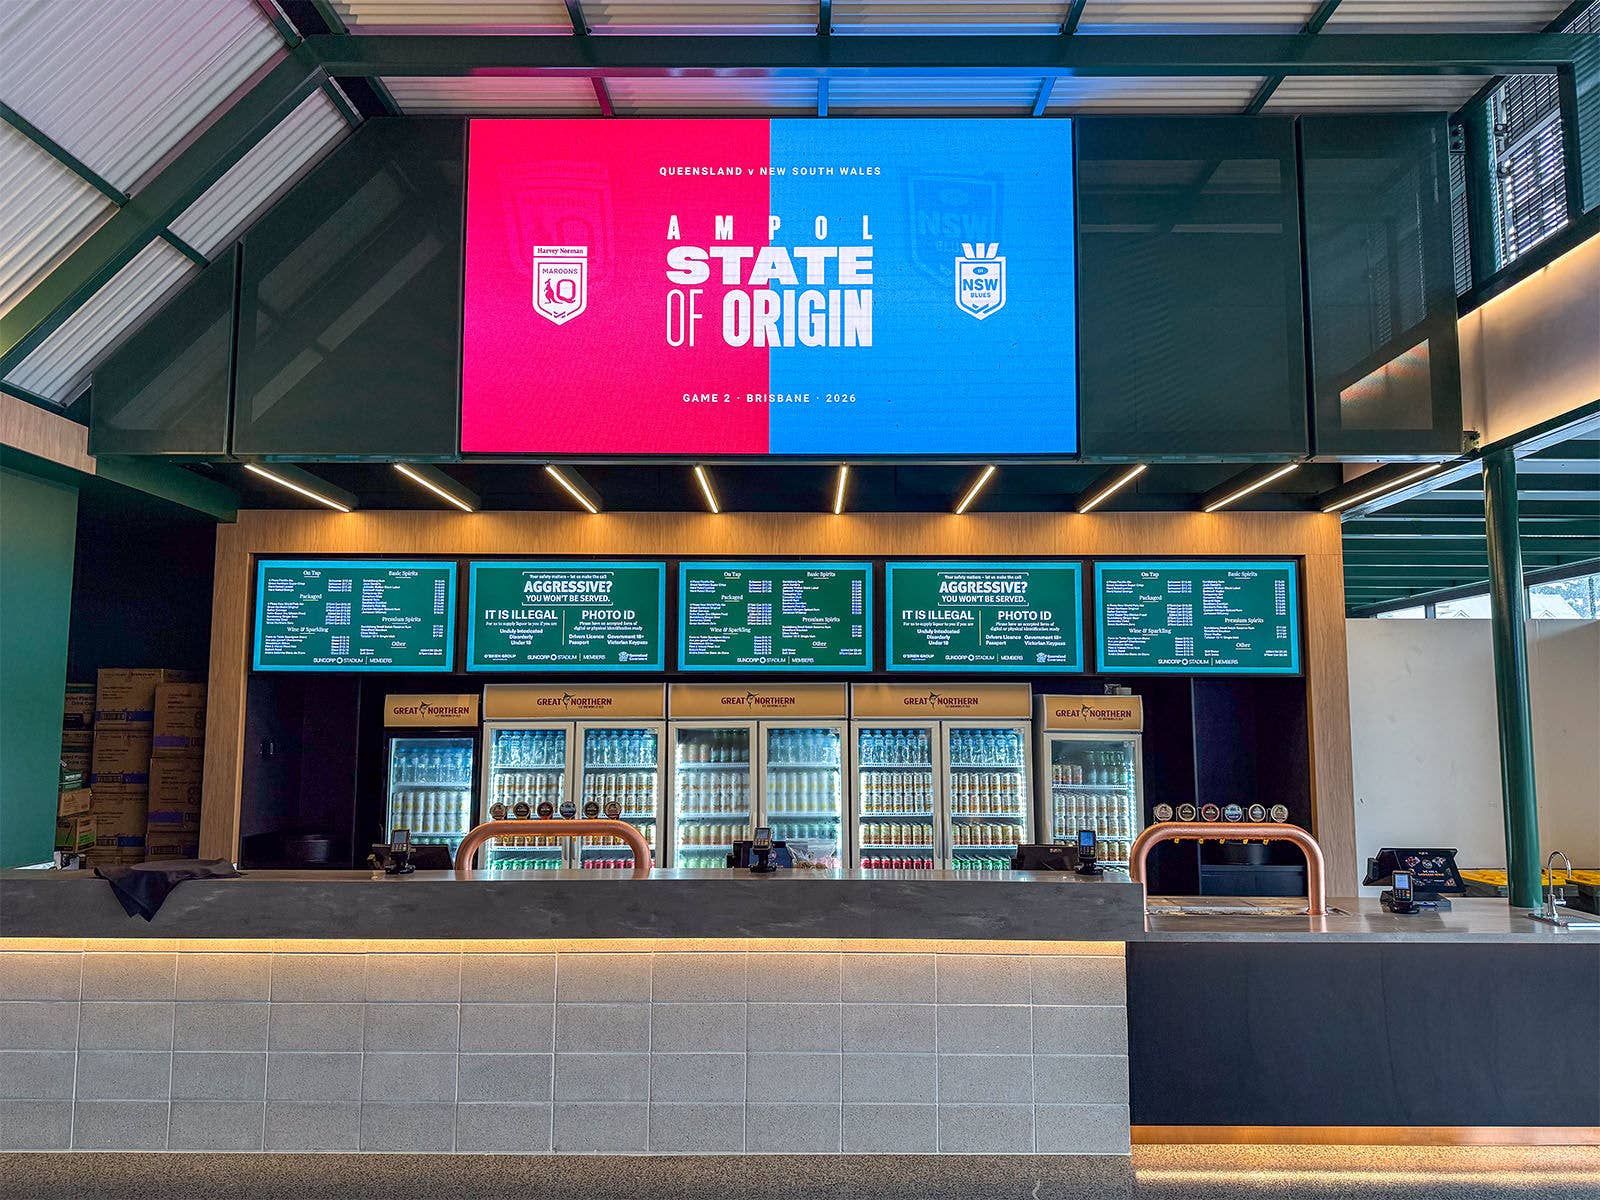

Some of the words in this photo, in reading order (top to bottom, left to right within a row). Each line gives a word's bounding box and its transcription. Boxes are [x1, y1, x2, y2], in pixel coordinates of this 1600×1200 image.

[659, 167, 743, 176] QUEENSLAND
[748, 167, 754, 176] v
[760, 167, 788, 176] NEW
[792, 167, 835, 176] SOUTH
[839, 167, 881, 176] WALES
[667, 215, 873, 240] AMPOL
[666, 246, 873, 285] STATE
[963, 279, 998, 291] NSW
[666, 289, 703, 347] OF
[723, 289, 873, 347] ORIGIN
[683, 393, 718, 403] GAME
[723, 393, 731, 403] 2
[746, 393, 810, 403] BRISBANE
[826, 393, 856, 403] 2026
[523, 581, 613, 593] AGGRESSIVE?
[938, 581, 1028, 594] AGGRESSIVE?
[942, 595, 958, 603] YOU
[958, 595, 984, 603] WON'T
[985, 595, 994, 603] BE
[995, 595, 1026, 603] SERVED.
[485, 610, 496, 620] IT
[498, 610, 508, 620] IS
[511, 610, 558, 620] ILLEGAL
[582, 610, 621, 620] PHOTO
[623, 610, 635, 620] ID
[902, 610, 913, 620] IT
[915, 610, 926, 620] IS
[928, 610, 974, 620] ILLEGAL
[998, 611, 1037, 620] PHOTO
[1040, 611, 1052, 620] ID
[393, 706, 418, 715] GREAT
[427, 706, 470, 715] NORTHERN
[1055, 709, 1080, 717] GREAT
[1090, 709, 1132, 717] NORTHERN
